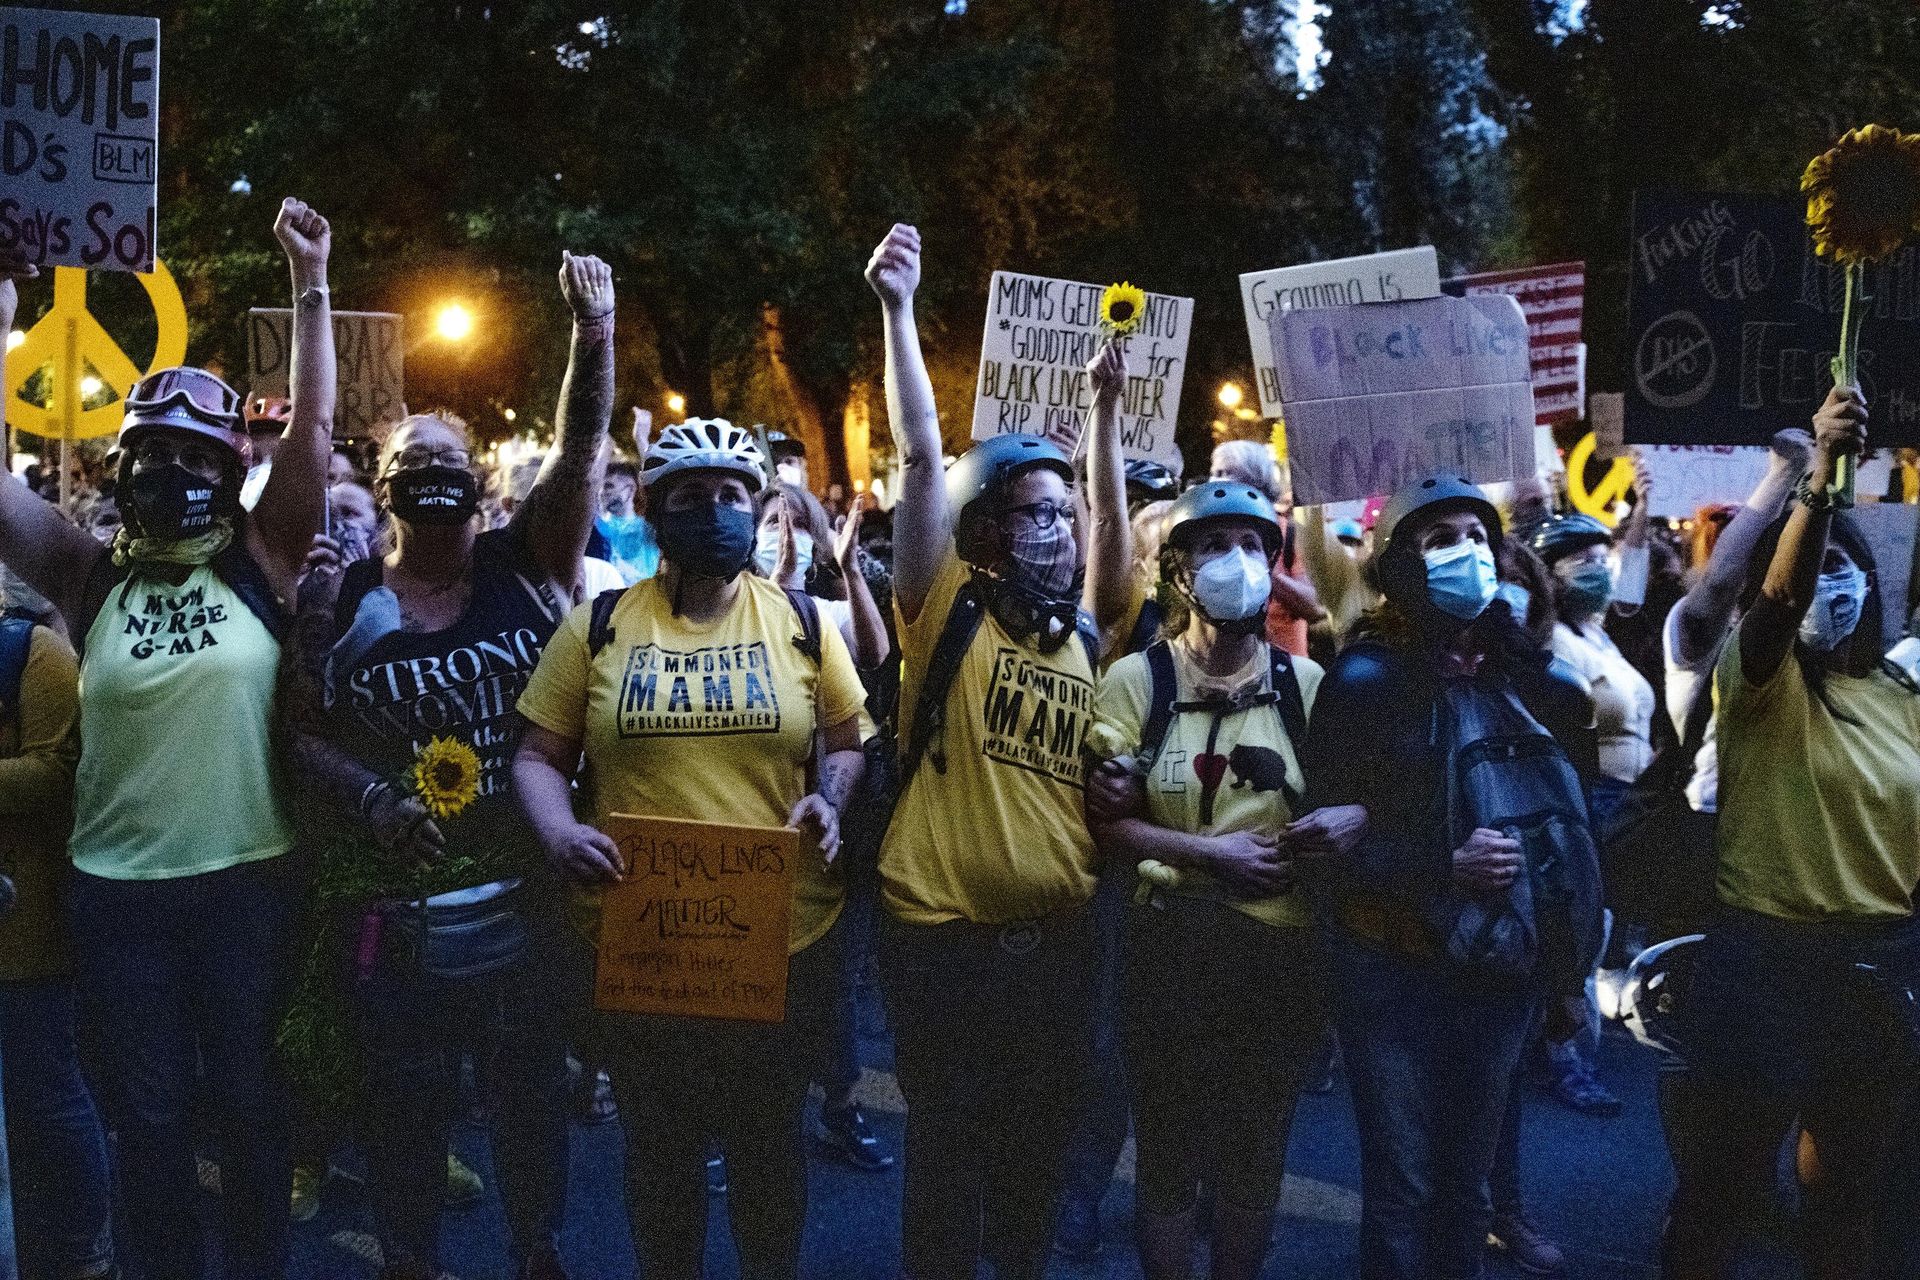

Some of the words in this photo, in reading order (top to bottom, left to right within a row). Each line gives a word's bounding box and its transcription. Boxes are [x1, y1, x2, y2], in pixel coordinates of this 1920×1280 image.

[2, 24, 155, 131] HOME
[99, 142, 151, 178] BLM
[0, 198, 72, 264] Says
[80, 201, 155, 274] So!
[997, 276, 1055, 321] MOMS
[1062, 283, 1103, 328] GETT
[1136, 294, 1179, 339] NTO
[1251, 279, 1363, 322] Gramma
[1147, 341, 1181, 379] for
[983, 360, 1042, 405] BLACK
[1048, 367, 1089, 409] LIVE
[1121, 375, 1165, 420] TTER
[997, 401, 1031, 434] RIP
[1035, 407, 1088, 438] JOHN
[1119, 416, 1155, 452] WIS
[185, 488, 213, 501] BLACK
[409, 485, 439, 495] BLACK
[442, 486, 464, 498] LIVES
[417, 497, 458, 506] MATTER
[124, 603, 228, 637] NURSE
[143, 585, 204, 616] MOM
[130, 629, 219, 660] G-MA
[634, 650, 761, 674] SUMMONED
[350, 627, 543, 710] STRONG
[1001, 657, 1088, 712] SUMMONE
[356, 671, 527, 742] WOME
[625, 672, 771, 713] MAMA
[625, 713, 772, 731] #BLACKLIVESMATTER
[1161, 751, 1187, 794] I
[617, 833, 717, 888] BLACK
[719, 840, 785, 875] LIVES
[638, 894, 751, 940] MATTER
